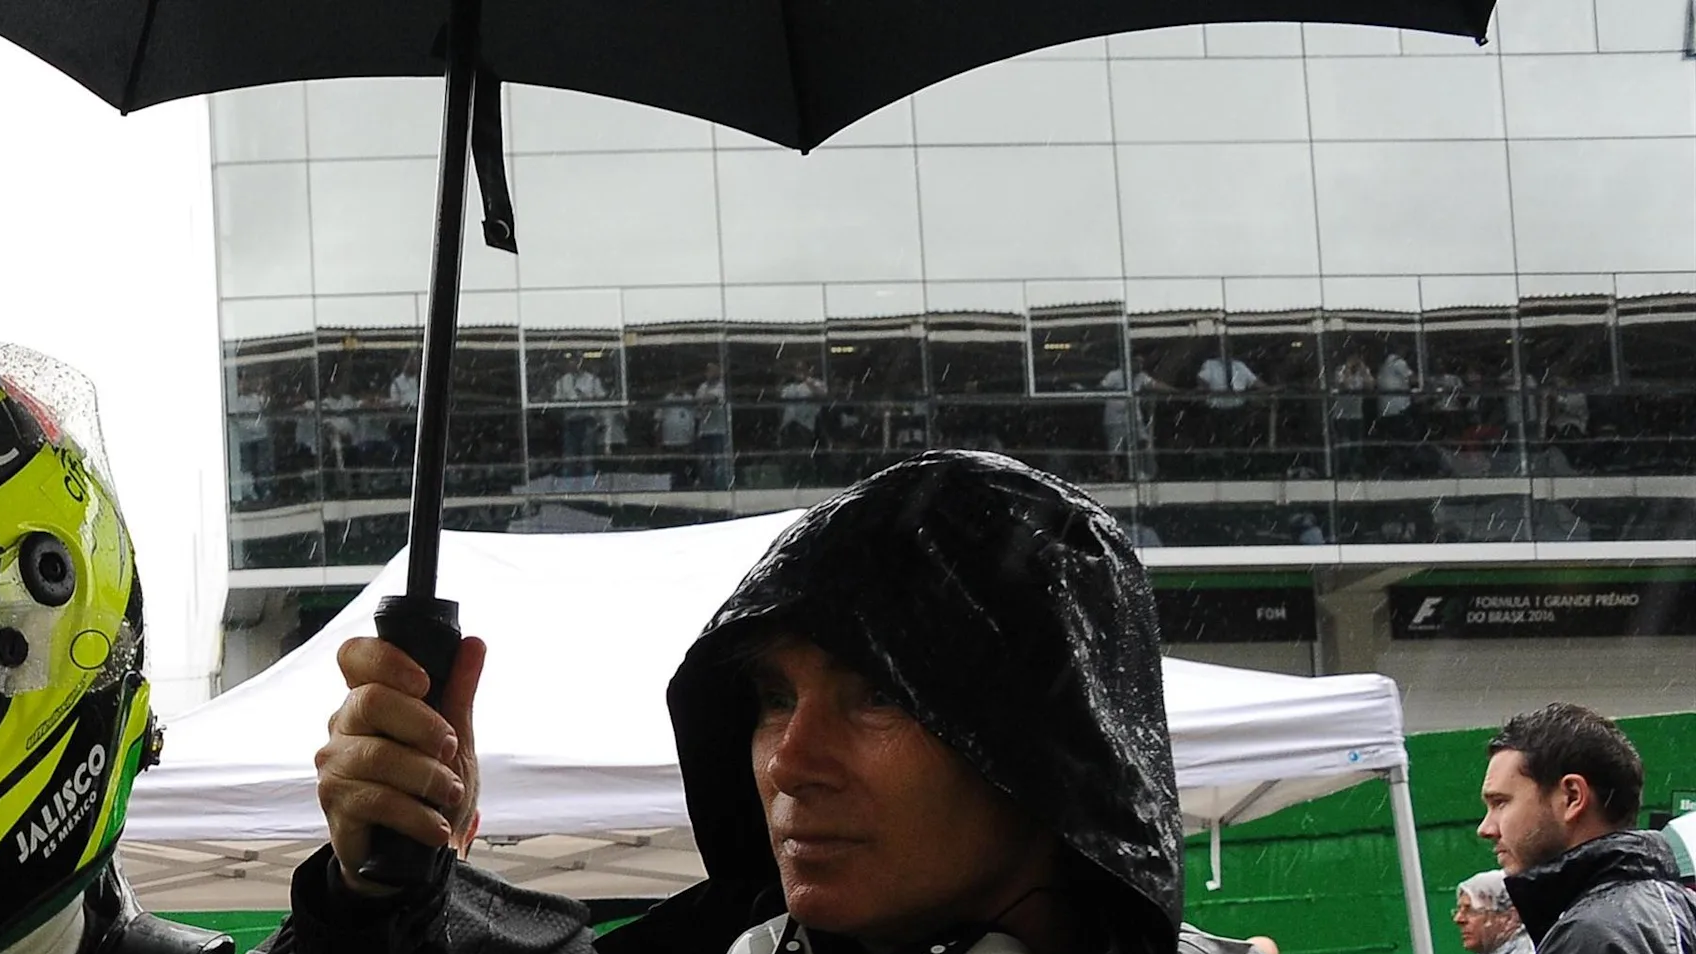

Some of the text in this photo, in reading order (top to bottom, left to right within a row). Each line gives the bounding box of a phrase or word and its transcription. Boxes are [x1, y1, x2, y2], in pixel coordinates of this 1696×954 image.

[1474, 595, 1531, 609] FORMULA
[1544, 594, 1592, 608] GRANDE
[1466, 611, 1486, 624] DO
[16, 743, 105, 864] JALISCO
[43, 840, 57, 859] ES
